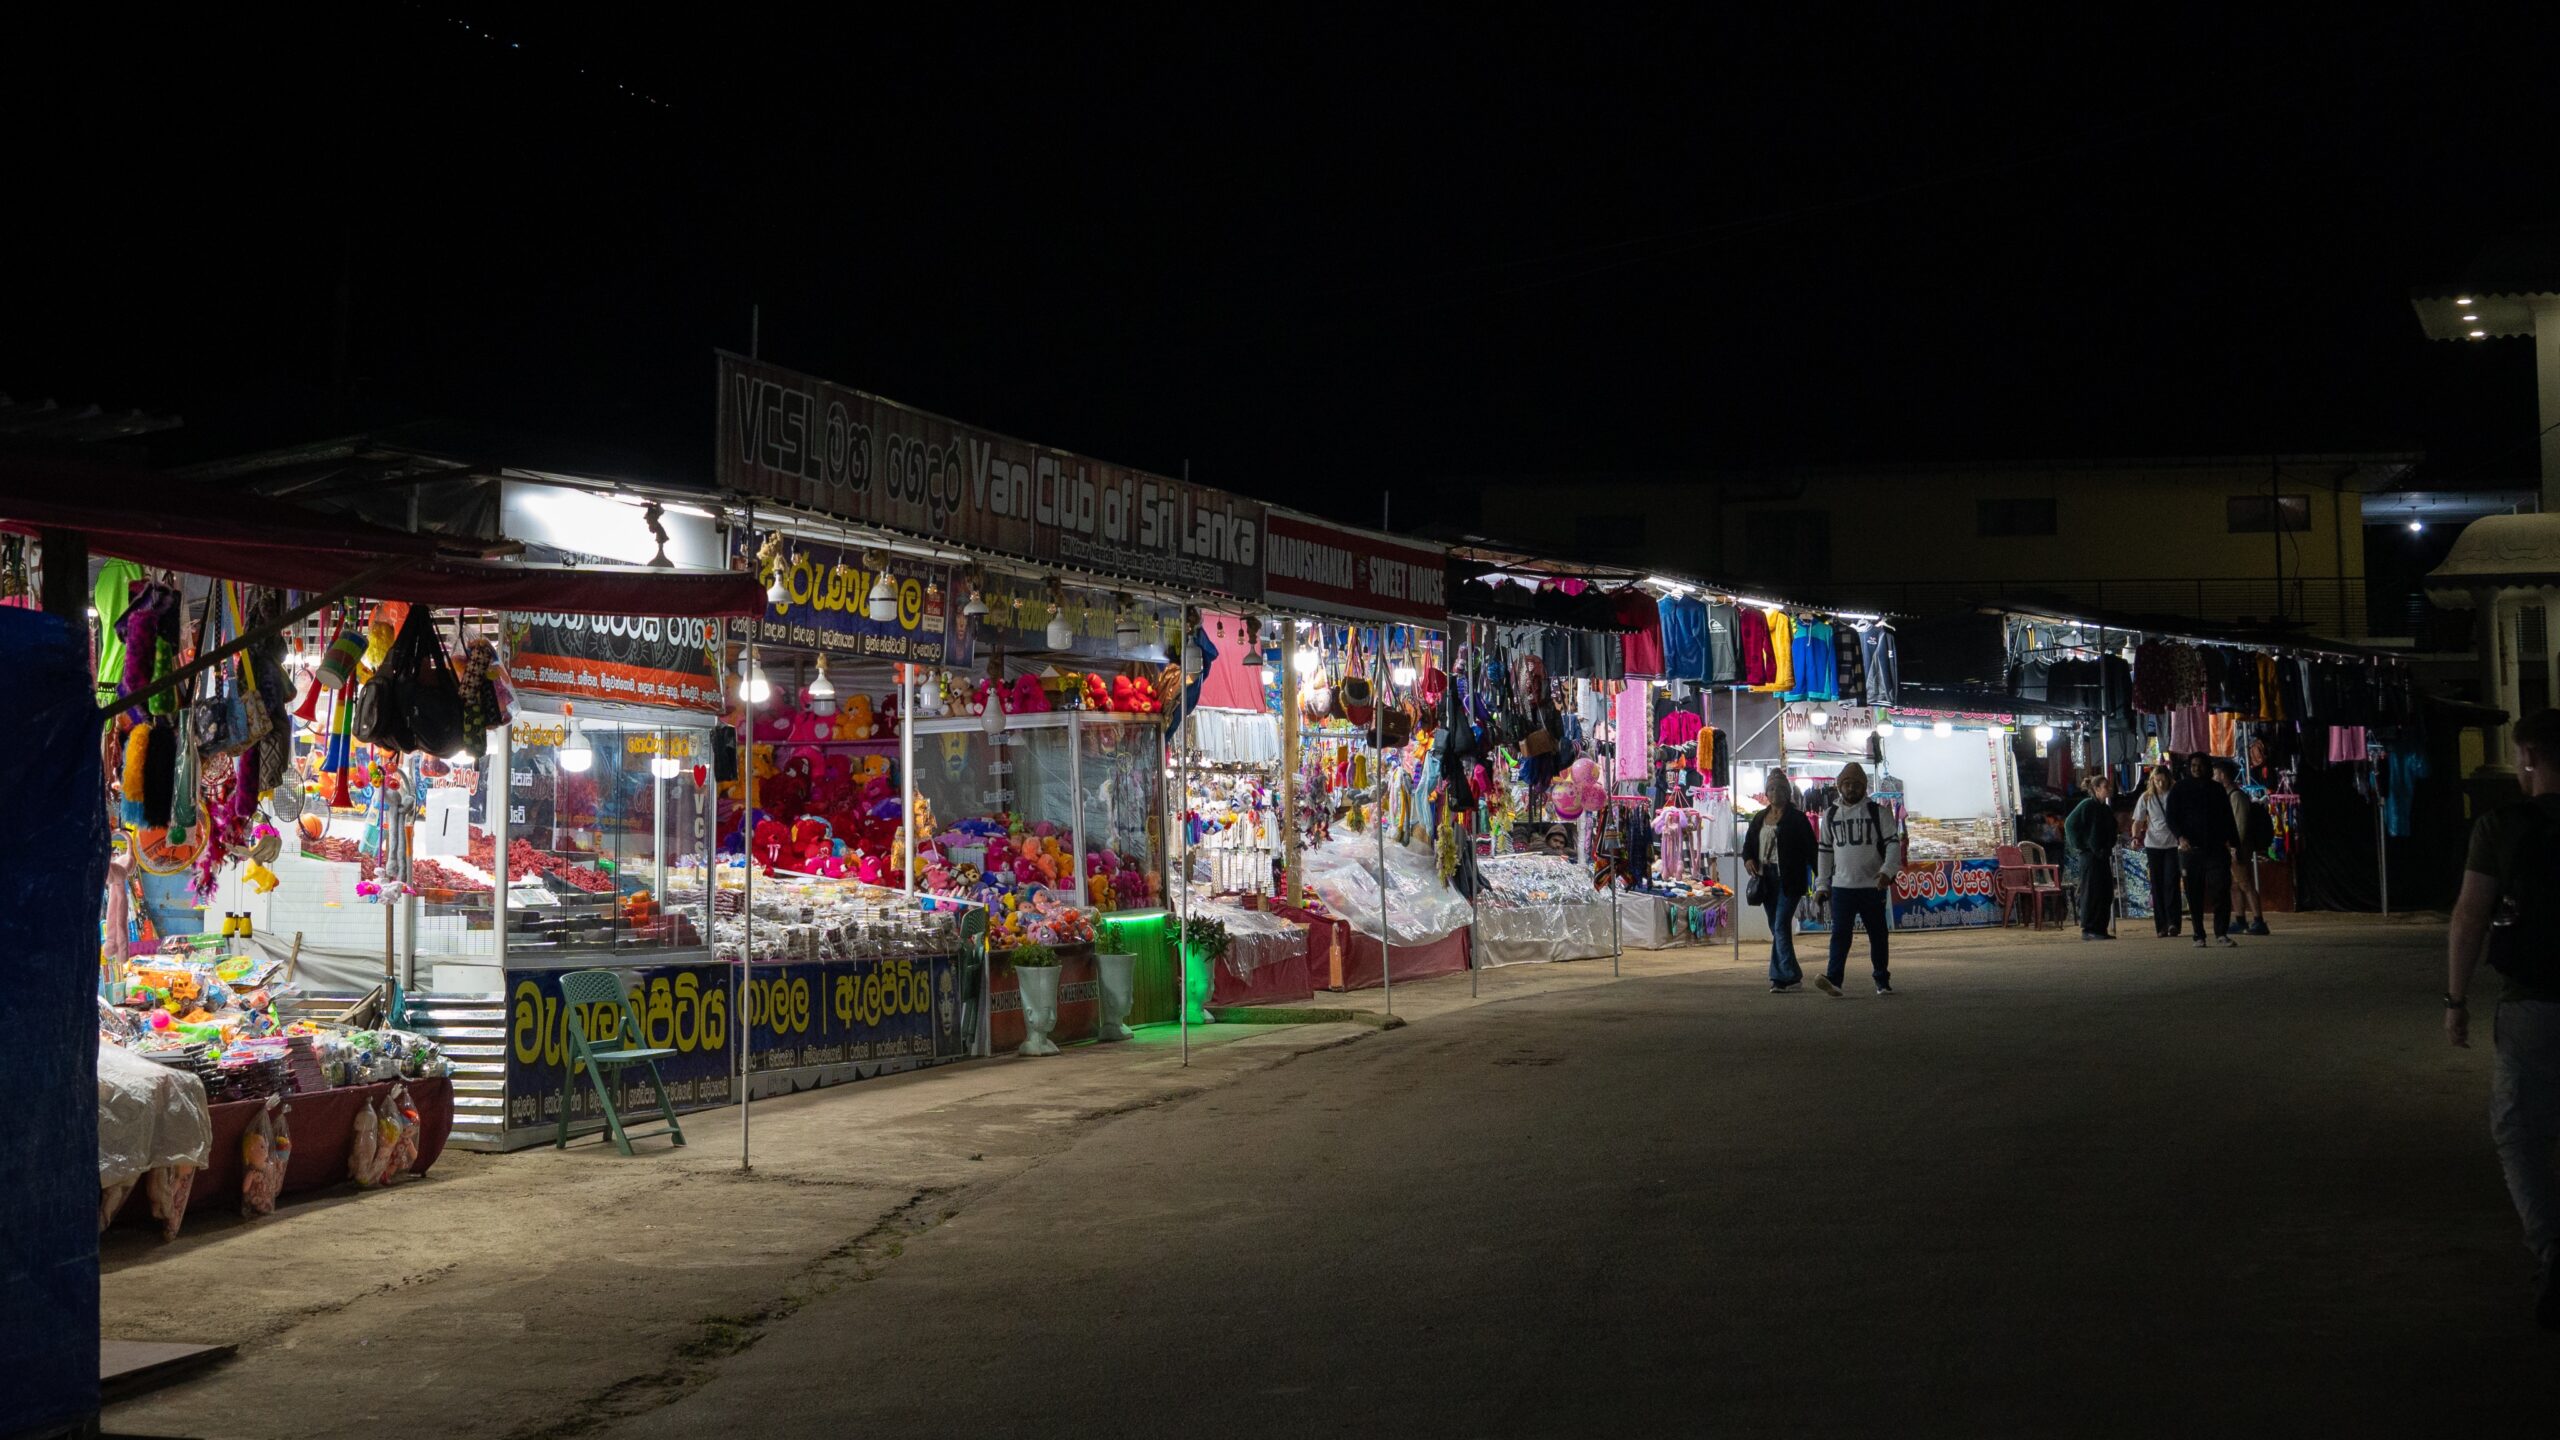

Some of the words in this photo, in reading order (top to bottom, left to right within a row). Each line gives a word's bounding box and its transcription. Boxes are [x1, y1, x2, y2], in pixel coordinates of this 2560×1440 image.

[736, 373, 822, 484] VCSL
[969, 437, 1030, 520] Van
[1035, 456, 1096, 535] Club
[1103, 478, 1133, 543] of
[1140, 481, 1176, 549] Sri
[1181, 488, 1256, 567] Lanka
[1060, 534, 1071, 556] All
[1072, 536, 1090, 560] Your
[1089, 541, 1115, 565] Needs
[1115, 547, 1146, 571] Together
[1146, 552, 1164, 576] Shop
[1267, 533, 1354, 590] MADUSHANKA
[1369, 555, 1407, 600] SWEET
[1409, 564, 1446, 606] HOUSE
[1832, 818, 1873, 847] OUI
